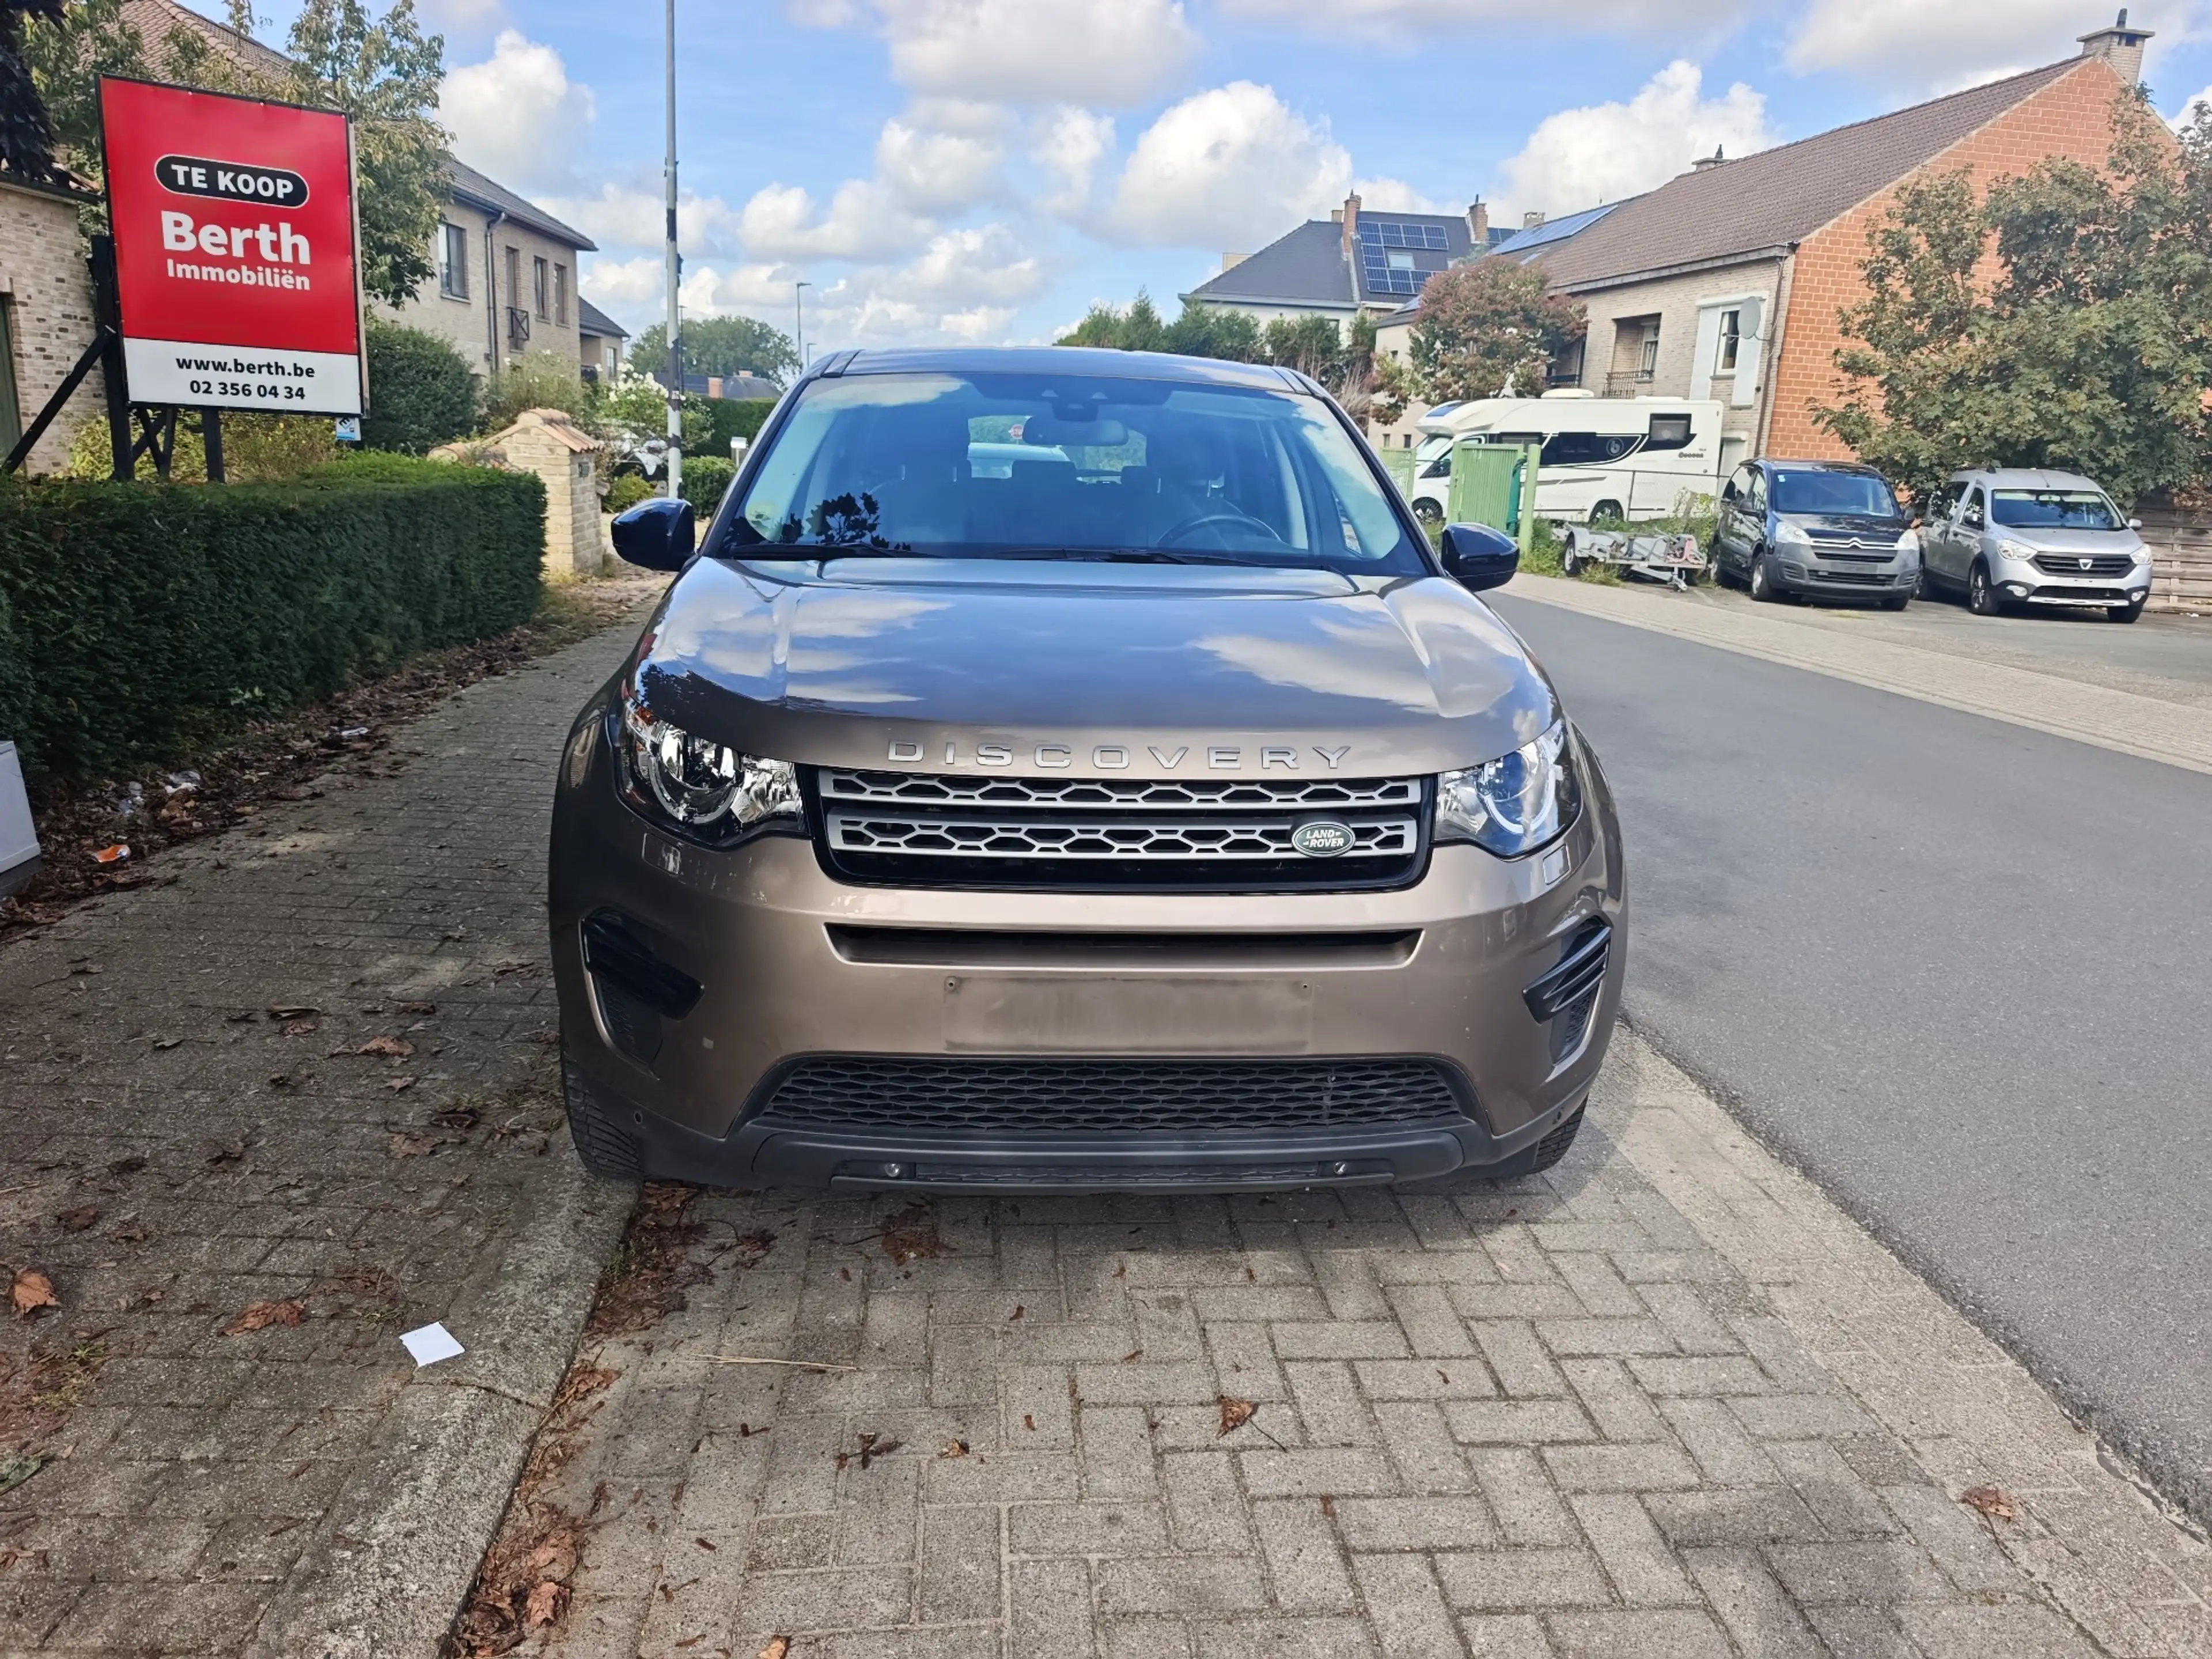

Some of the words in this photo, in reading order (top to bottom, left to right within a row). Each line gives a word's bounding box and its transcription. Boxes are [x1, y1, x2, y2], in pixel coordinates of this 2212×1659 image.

[171, 164, 208, 189] TE
[217, 171, 294, 199] KOOP
[161, 210, 310, 265] Berth
[167, 258, 310, 290] Immobiliën
[176, 358, 315, 377] www.berth.be
[190, 380, 213, 395] 02
[218, 381, 252, 397] 356
[257, 384, 279, 398] 04
[283, 386, 305, 400] 34
[888, 740, 1351, 770] DISCOVERY
[1306, 829, 1335, 839] LAND
[1308, 837, 1344, 848] ROVER
